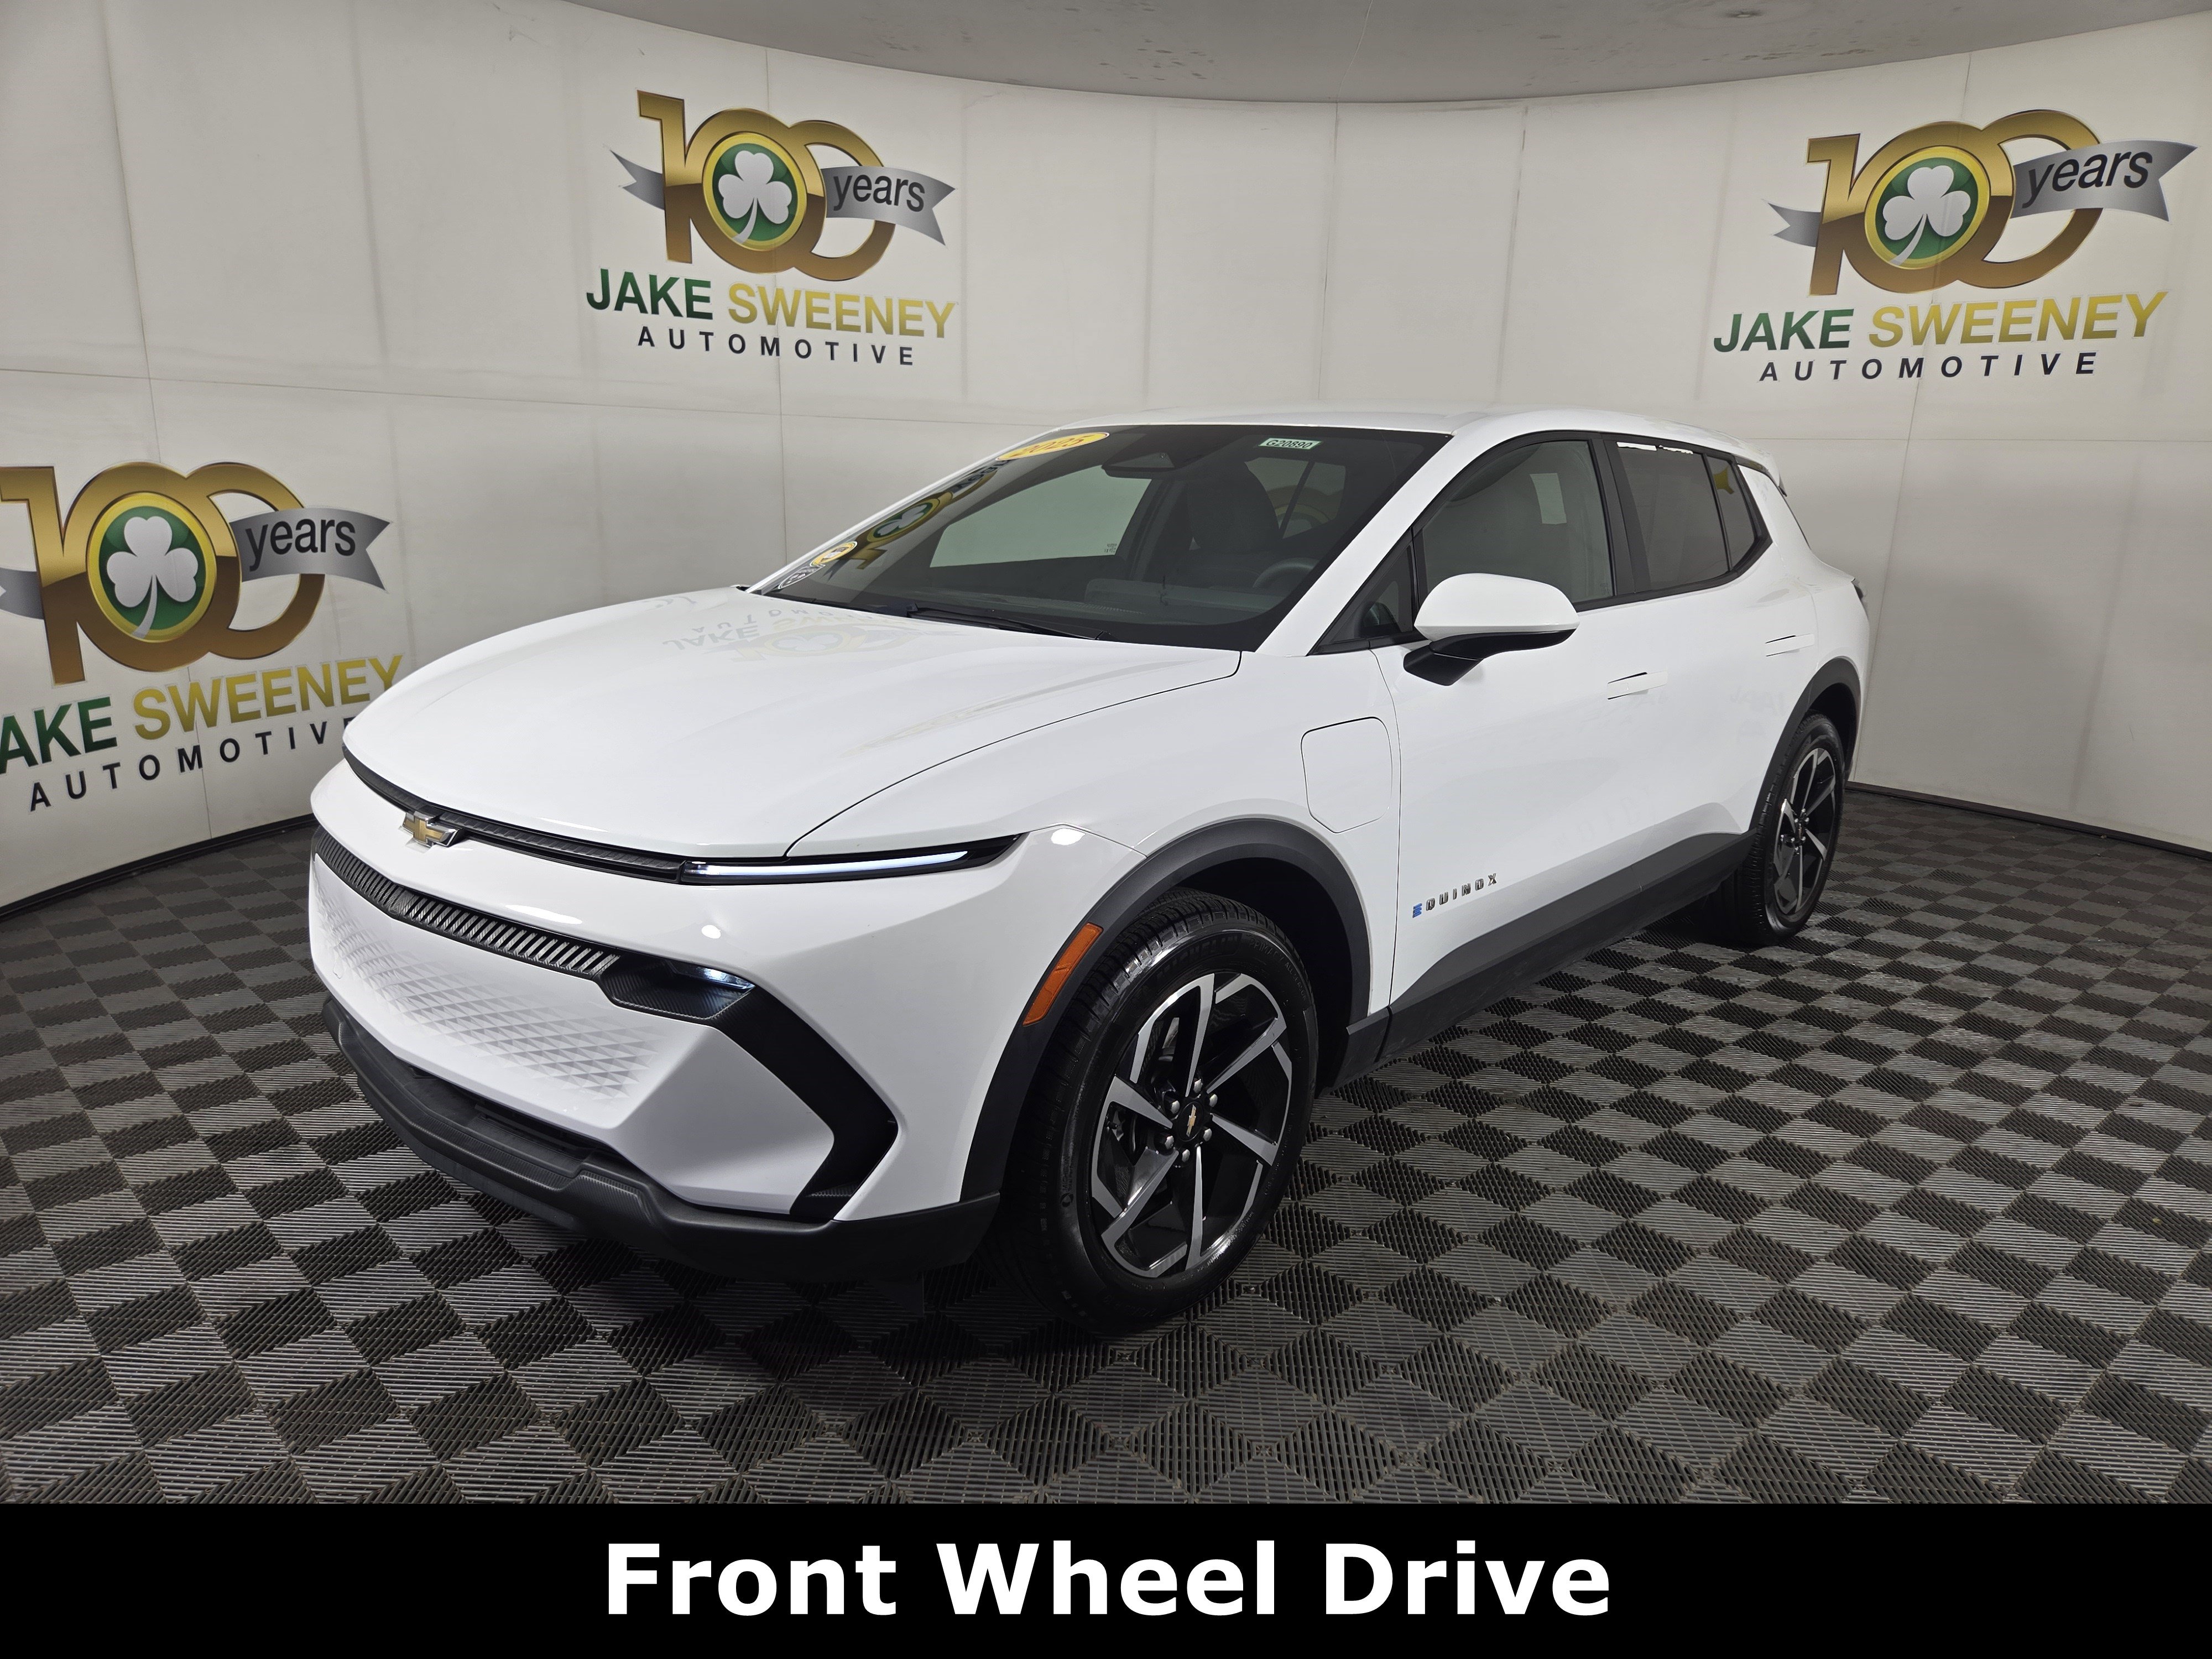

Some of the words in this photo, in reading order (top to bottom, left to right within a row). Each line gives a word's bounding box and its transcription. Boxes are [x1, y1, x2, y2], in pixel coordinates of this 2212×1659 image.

[637, 89, 896, 281] 100
[832, 173, 926, 212] years
[1806, 109, 2103, 296] 100
[2022, 150, 2153, 208] years
[586, 269, 713, 321] JAKE
[728, 283, 957, 338] SWEENEY
[1713, 308, 1854, 353] JAKE
[1868, 291, 2168, 348] SWEENEY
[638, 326, 914, 366] AUTOMOTIVE
[1760, 352, 2098, 382] AUTOMOTIVE
[1009, 434, 1095, 458] 2025
[1266, 440, 1313, 448] G20890
[245, 518, 357, 571] years
[0, 462, 326, 686] 100
[0, 696, 118, 774] AKE
[133, 655, 404, 740] SWEENEY
[1412, 873, 1497, 918] EQUINOX
